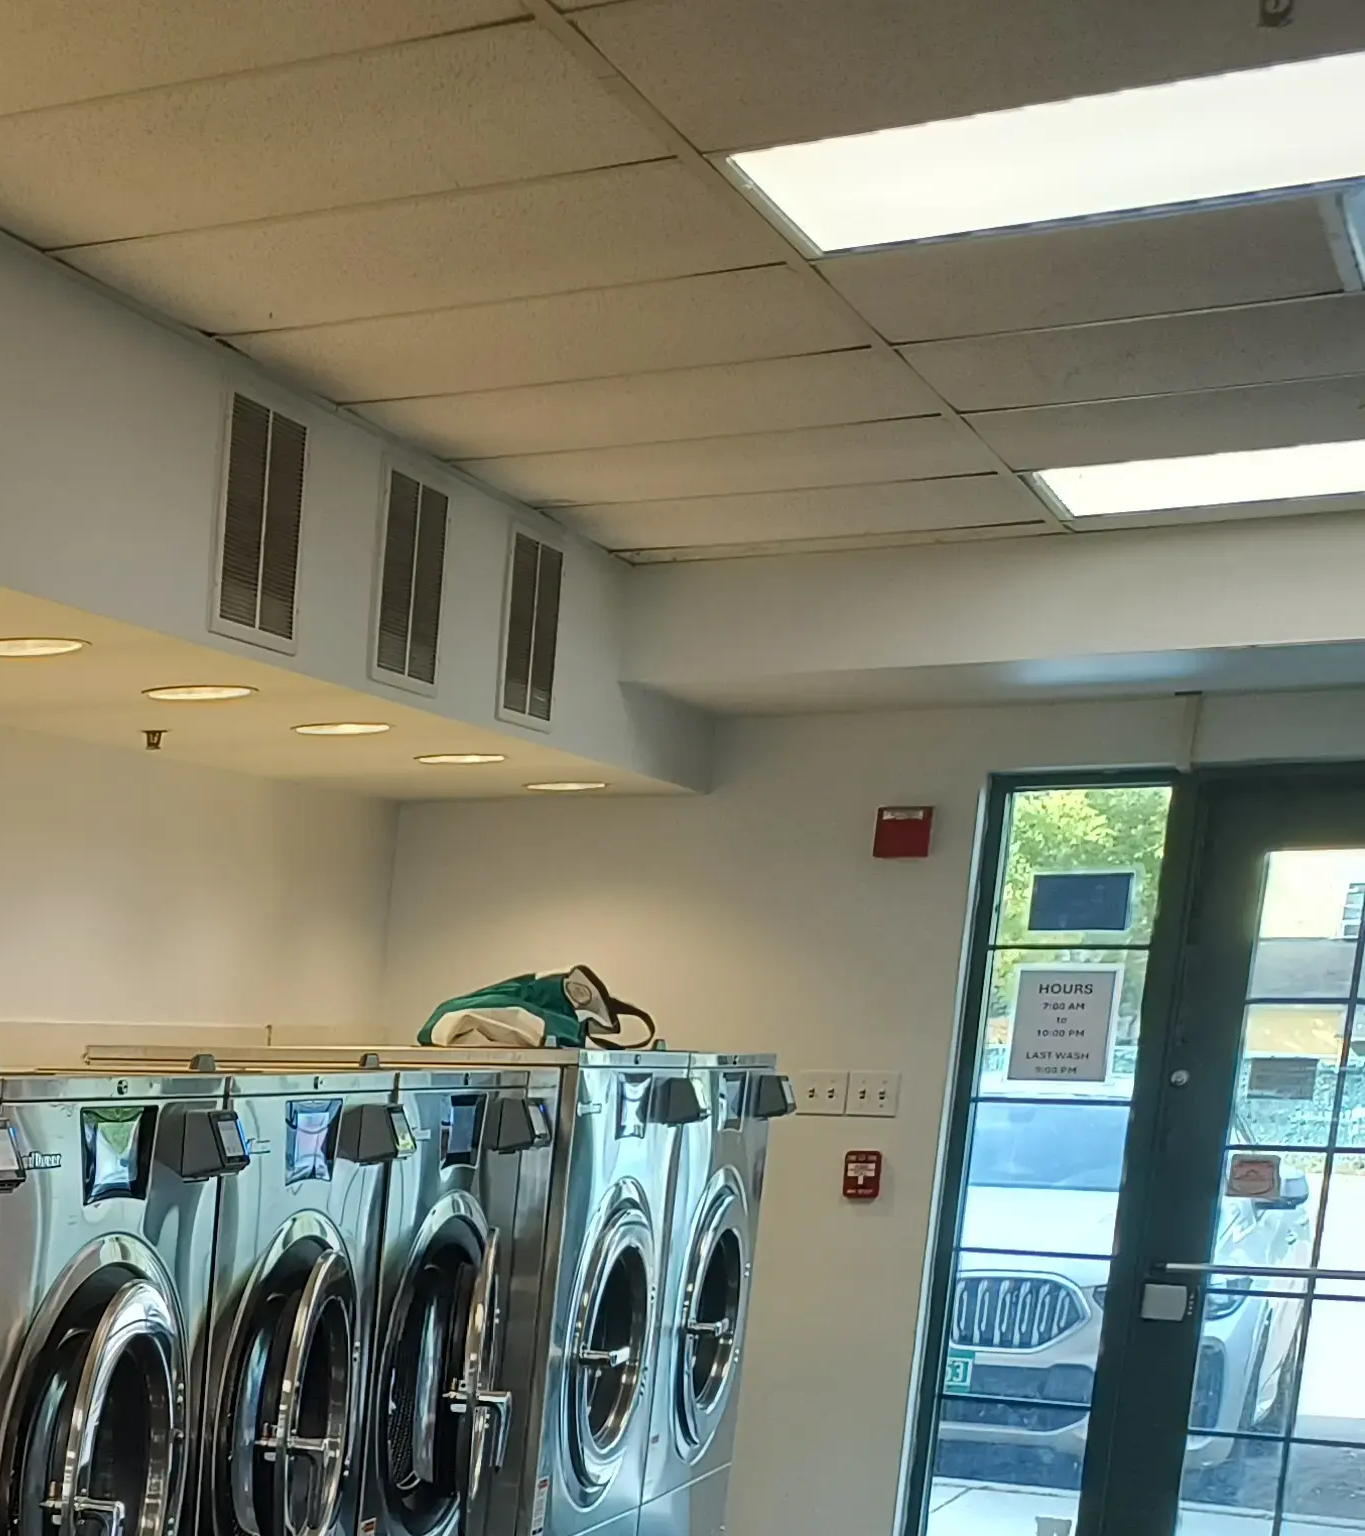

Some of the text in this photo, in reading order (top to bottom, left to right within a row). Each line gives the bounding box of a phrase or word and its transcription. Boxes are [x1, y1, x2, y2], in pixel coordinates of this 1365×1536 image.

[1038, 983, 1094, 995] HOURS
[1042, 1002, 1085, 1011] 7:00 AM
[1056, 1016, 1068, 1024] to
[1037, 1029, 1085, 1038] 10:00 PM
[1025, 1051, 1090, 1061] LAST WASH
[1060, 1066, 1077, 1075] PM
